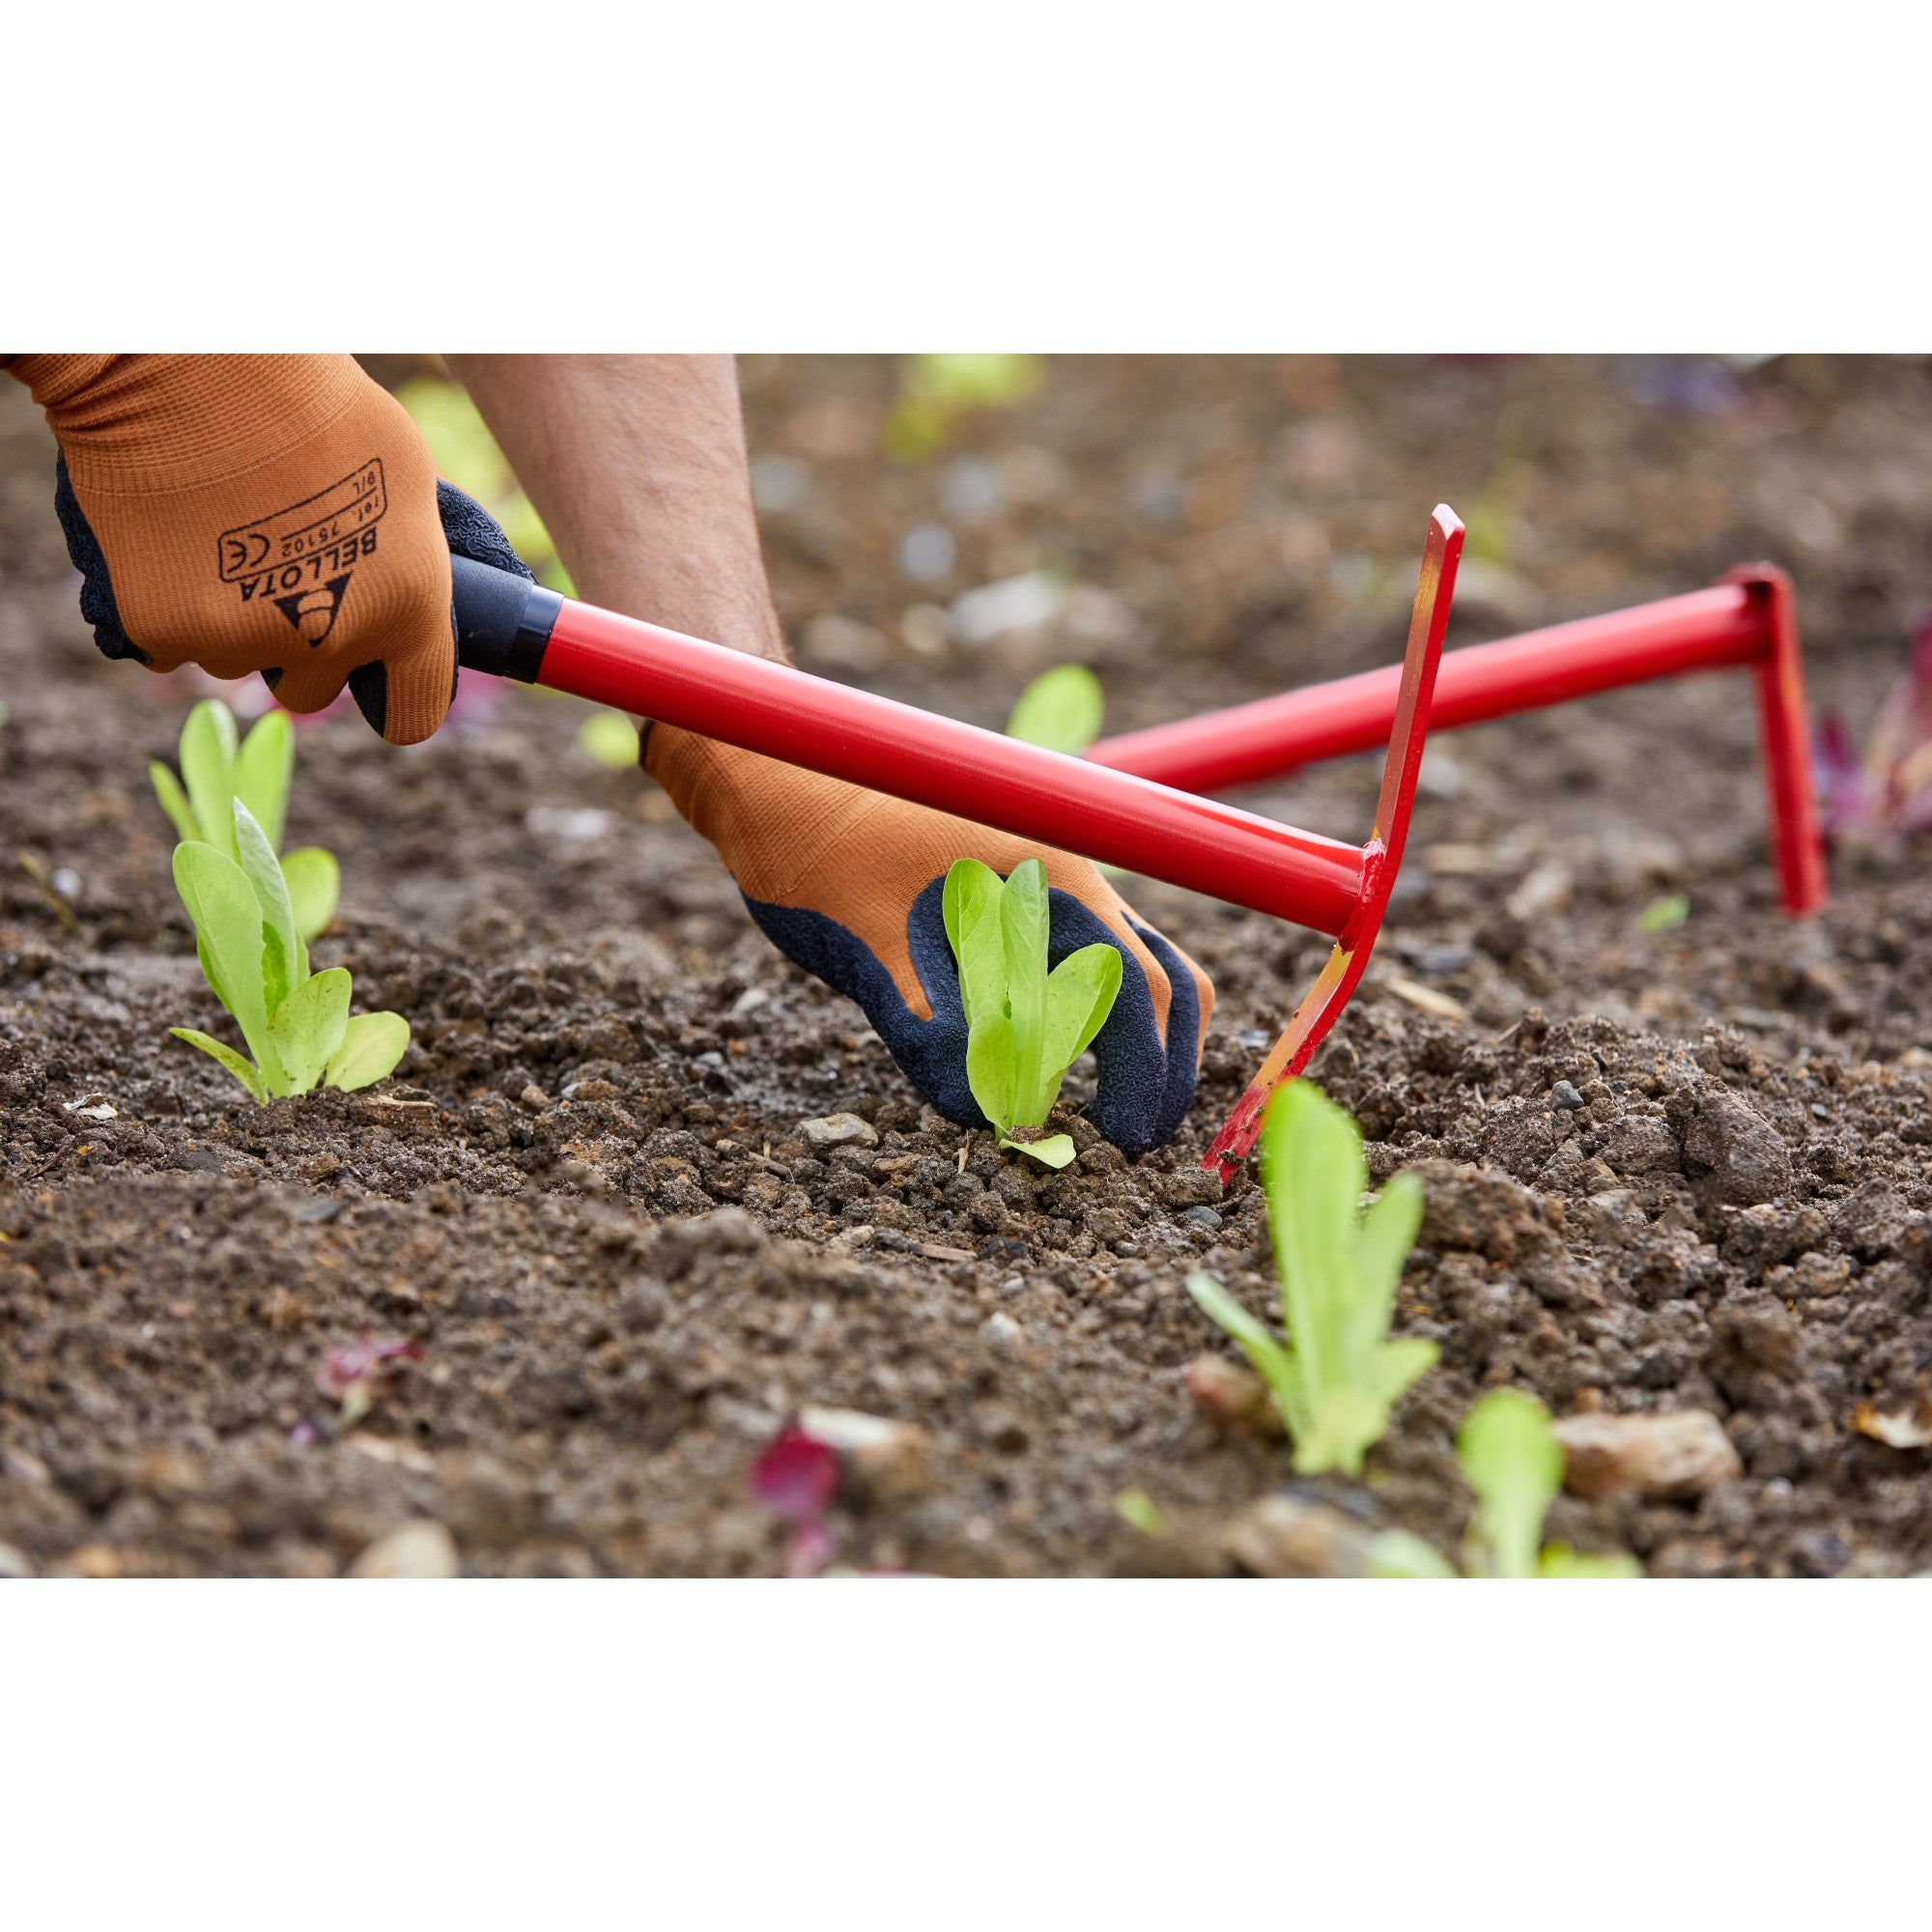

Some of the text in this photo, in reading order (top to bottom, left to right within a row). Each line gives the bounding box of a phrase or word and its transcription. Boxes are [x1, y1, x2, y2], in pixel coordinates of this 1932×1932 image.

[226, 533, 270, 575] CE
[282, 522, 338, 557] 75102
[240, 526, 377, 602] BELLOTA
